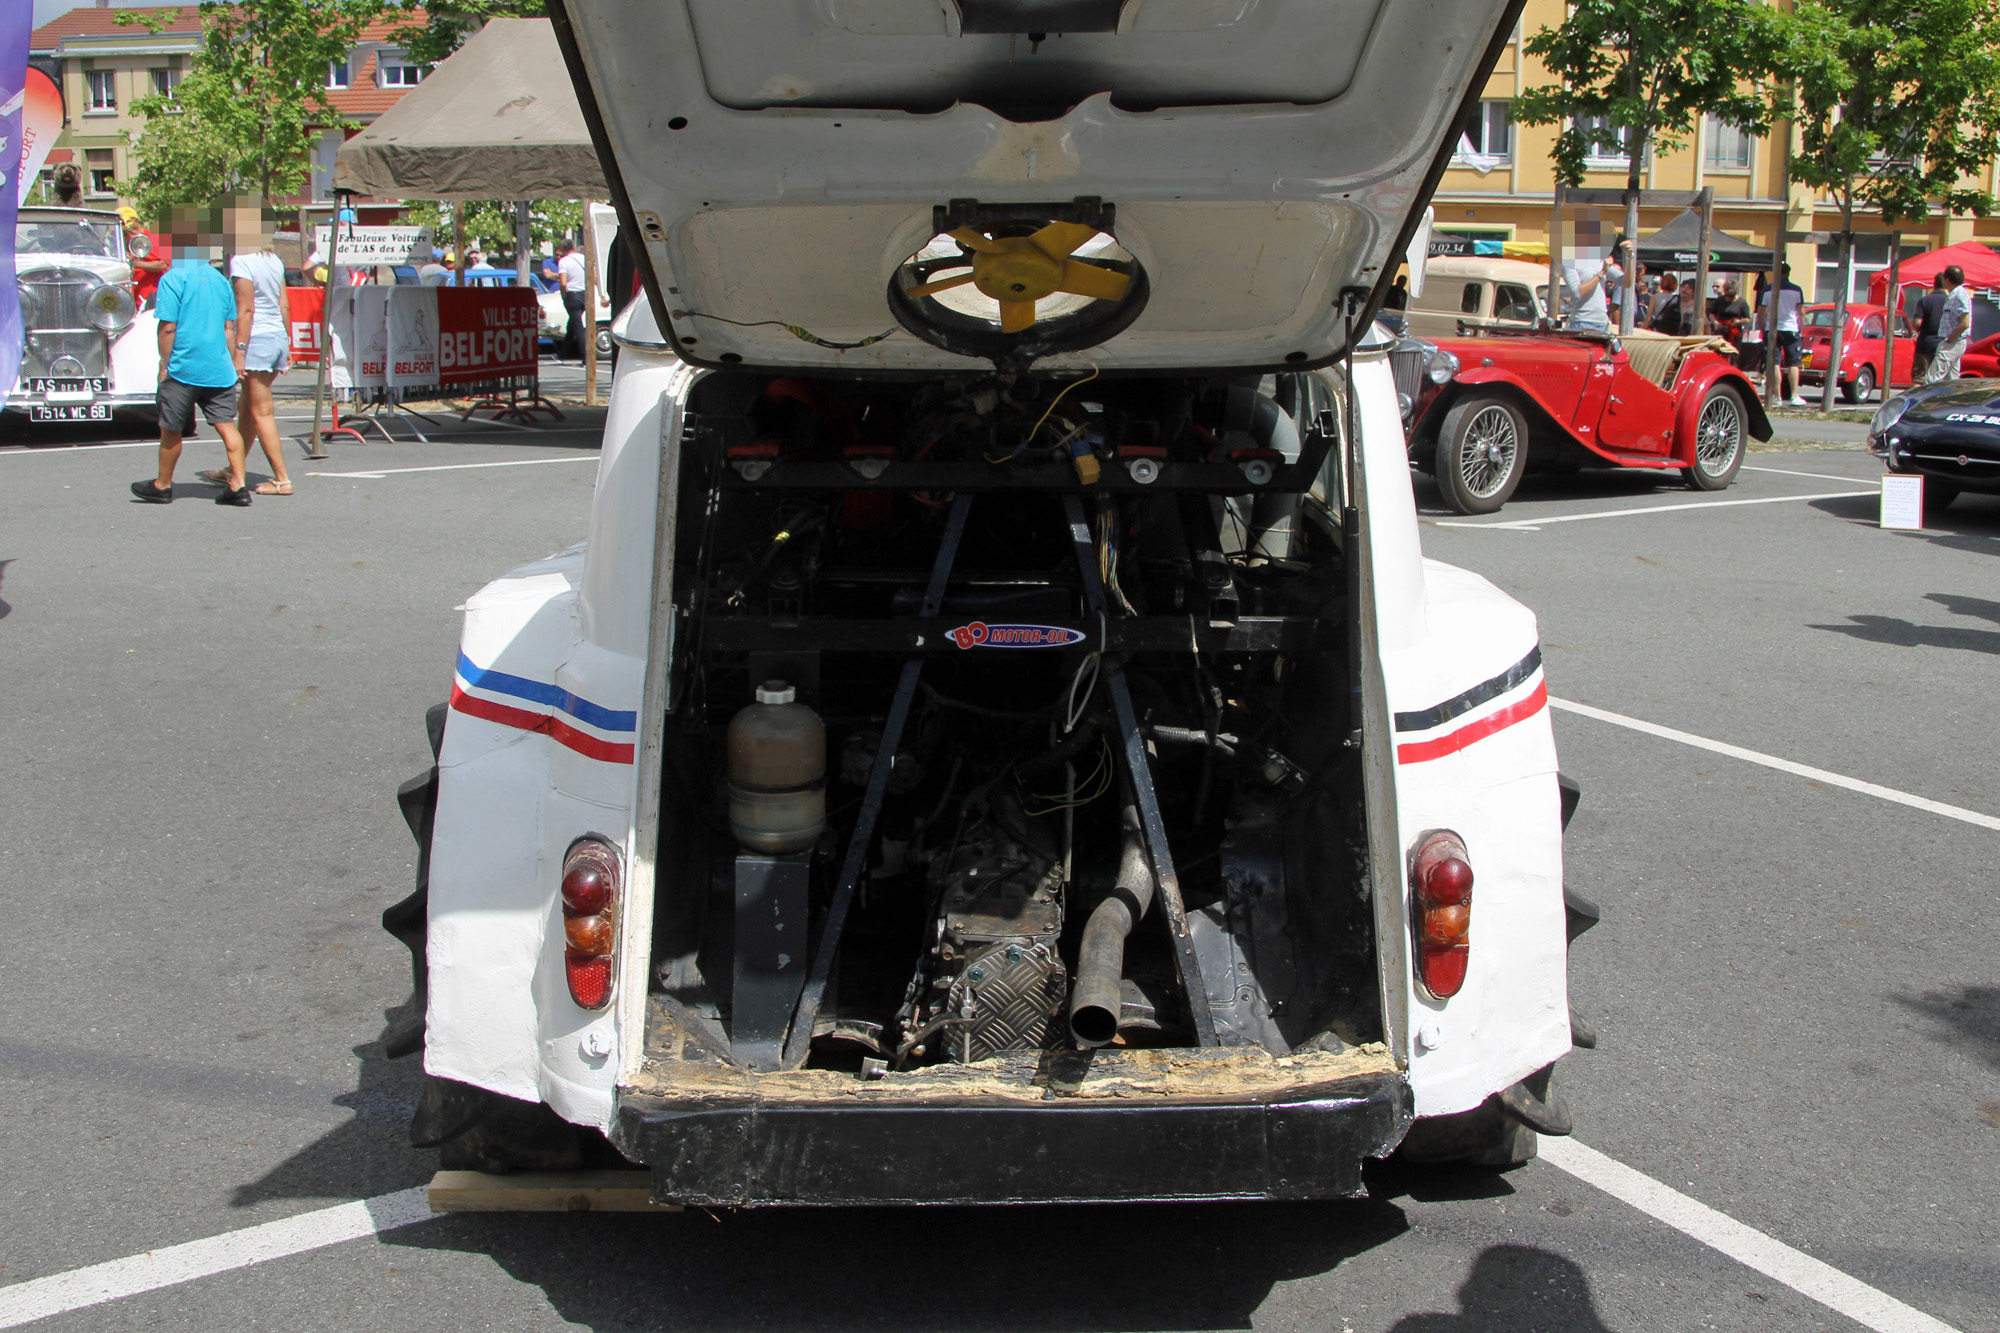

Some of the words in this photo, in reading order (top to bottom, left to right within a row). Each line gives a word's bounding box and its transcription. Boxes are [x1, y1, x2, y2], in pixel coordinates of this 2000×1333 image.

[339, 234, 387, 242] Fabuleuse
[392, 234, 427, 242] Voiture
[338, 245, 348, 253] de
[379, 245, 395, 253] des
[482, 307, 516, 327] VILLE
[520, 306, 537, 325] DE
[440, 327, 536, 367] BELFORT
[414, 353, 428, 361] VILLE
[394, 361, 435, 374] BELFORT
[36, 379, 56, 392] AS
[61, 383, 78, 392] DES
[83, 379, 102, 392] AS
[37, 406, 66, 419] 7514
[90, 405, 106, 418] 68
[953, 621, 989, 649] BO
[990, 629, 1070, 643] MOTOR-OIL
